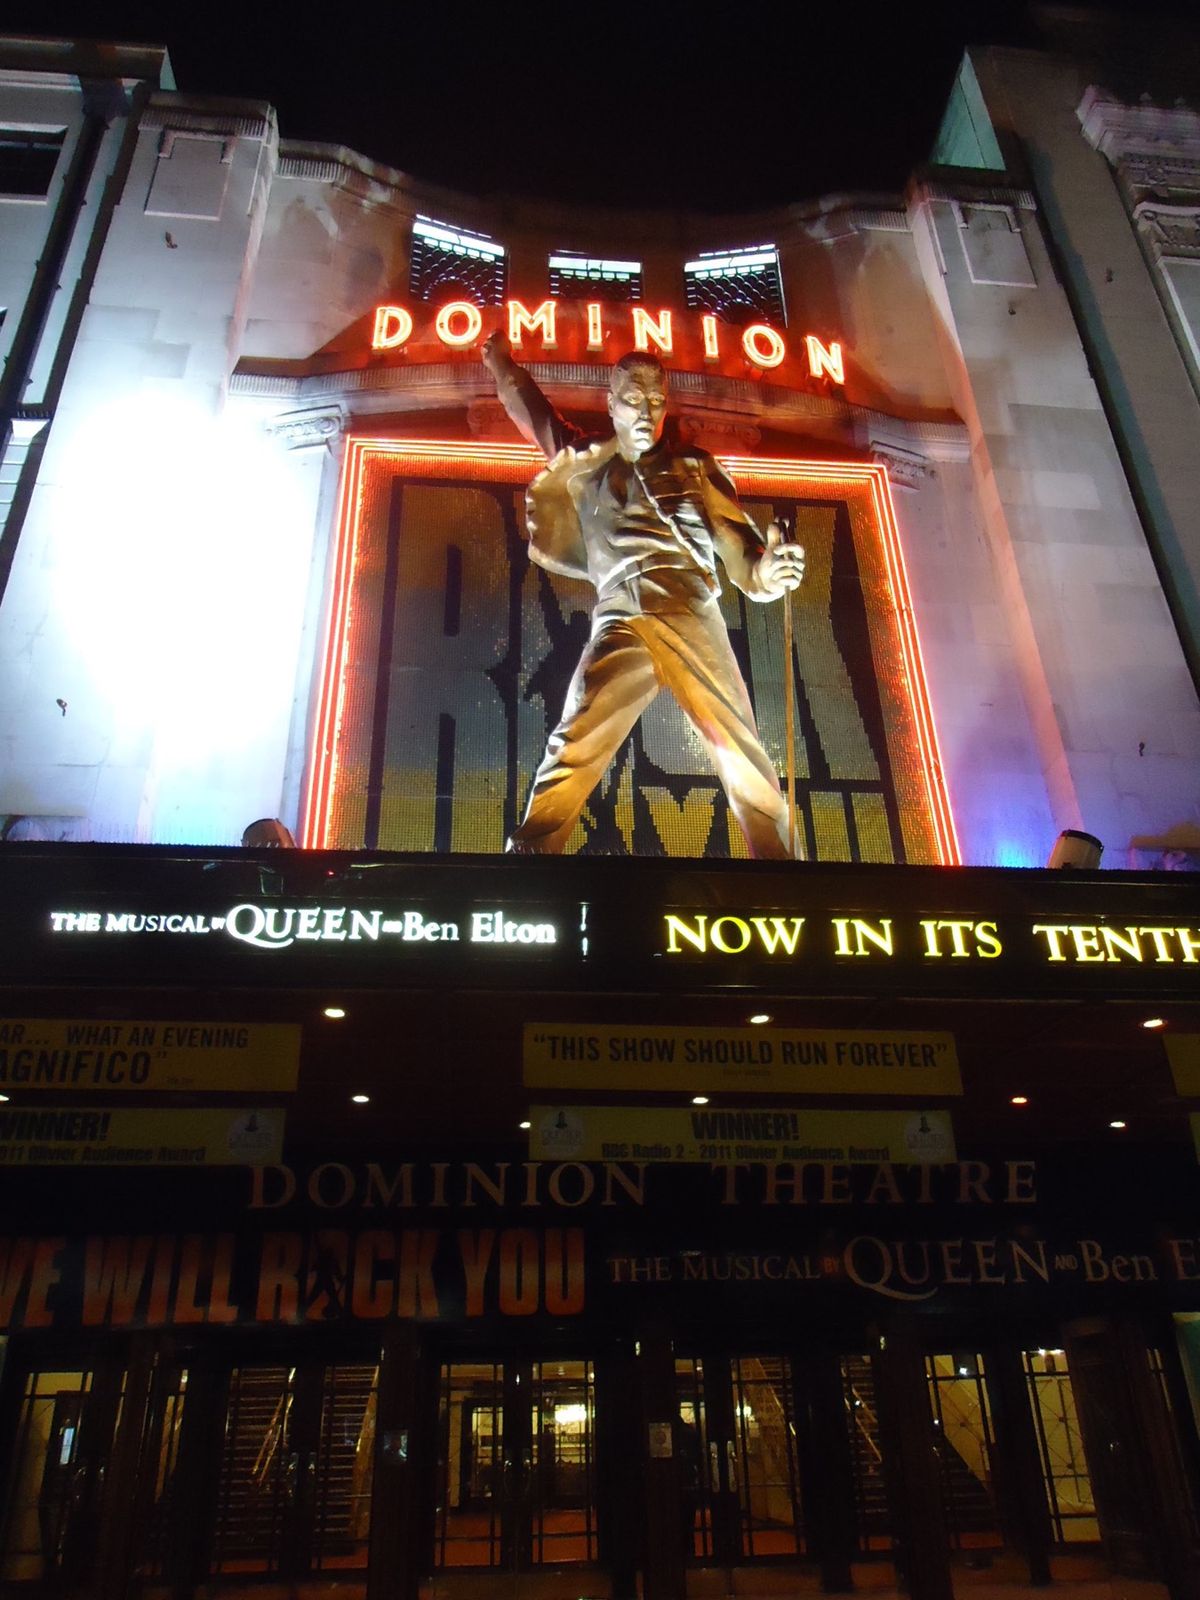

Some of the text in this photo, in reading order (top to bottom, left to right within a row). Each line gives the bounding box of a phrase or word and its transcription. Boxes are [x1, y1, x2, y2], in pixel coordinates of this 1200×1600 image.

[371, 300, 846, 387] DOMINION
[50, 912, 101, 933] THE
[104, 912, 211, 934] MUSICAL
[226, 903, 383, 949] QUEEN
[402, 910, 460, 941] Ben
[470, 910, 557, 944] Elton
[663, 914, 1200, 963] NOW IN ITS TENTH
[66, 1025, 122, 1047] WHAT
[127, 1026, 156, 1047] AN
[162, 1027, 249, 1049] EVENING
[608, 1036, 676, 1063] SHOW
[684, 1038, 773, 1064] SHOULD
[780, 1040, 829, 1066] RUN
[690, 1110, 800, 1141] WINNER!
[246, 1159, 1038, 1209] DOMINION THEATRE
[81, 1231, 240, 1328] WILL
[456, 1226, 586, 1318] YOU
[606, 1256, 672, 1283] THE
[681, 1254, 822, 1282] MUSICAL
[843, 1235, 1051, 1301] QUEEN
[1076, 1238, 1159, 1284] Ben
